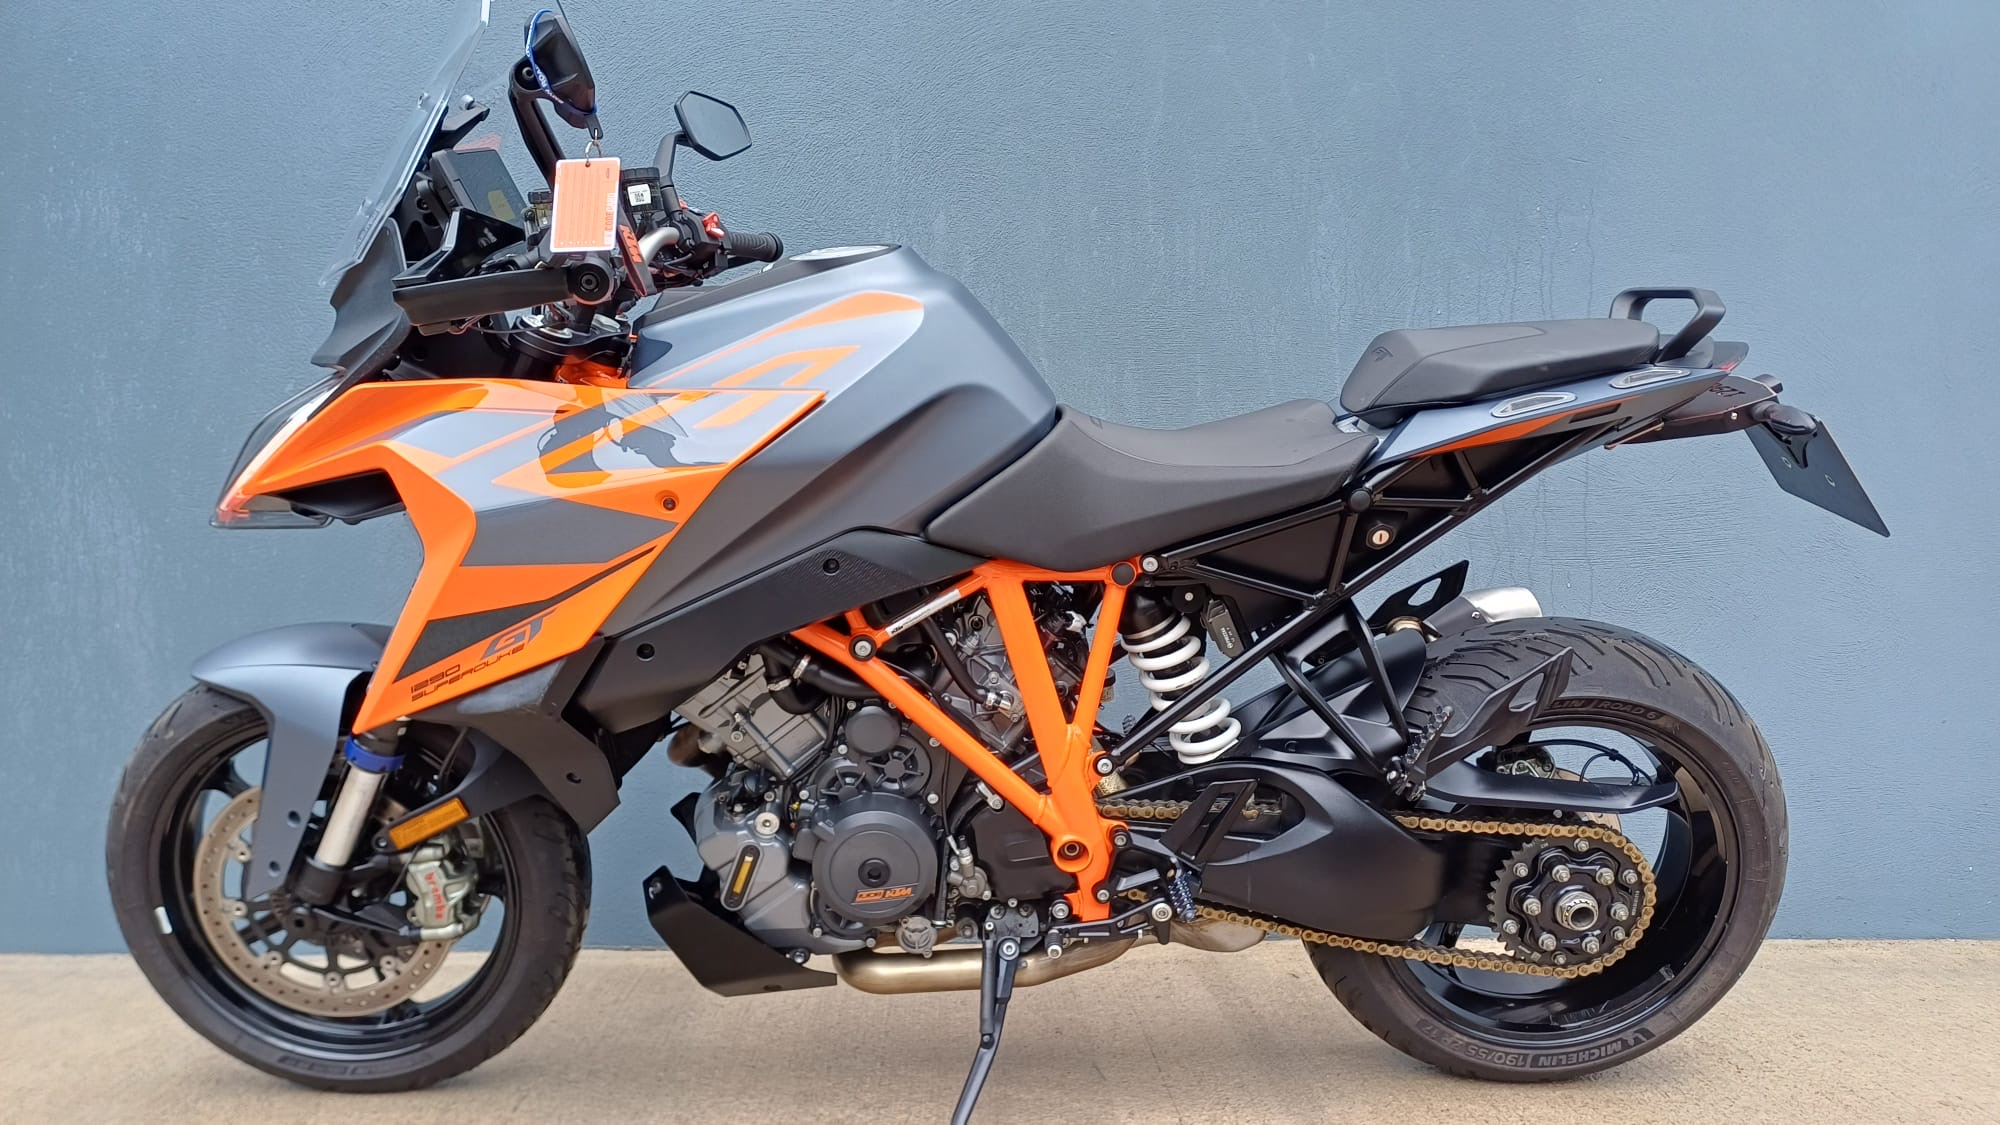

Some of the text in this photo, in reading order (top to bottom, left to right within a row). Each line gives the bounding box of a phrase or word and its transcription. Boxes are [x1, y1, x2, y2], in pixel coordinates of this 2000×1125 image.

[480, 607, 558, 660] GT
[411, 664, 461, 693] 1290
[1597, 700, 1645, 714] ROAD
[1646, 711, 1657, 720] 6
[1465, 1045, 1526, 1067] 190/55
[1538, 1040, 1623, 1067] MICHELIN
